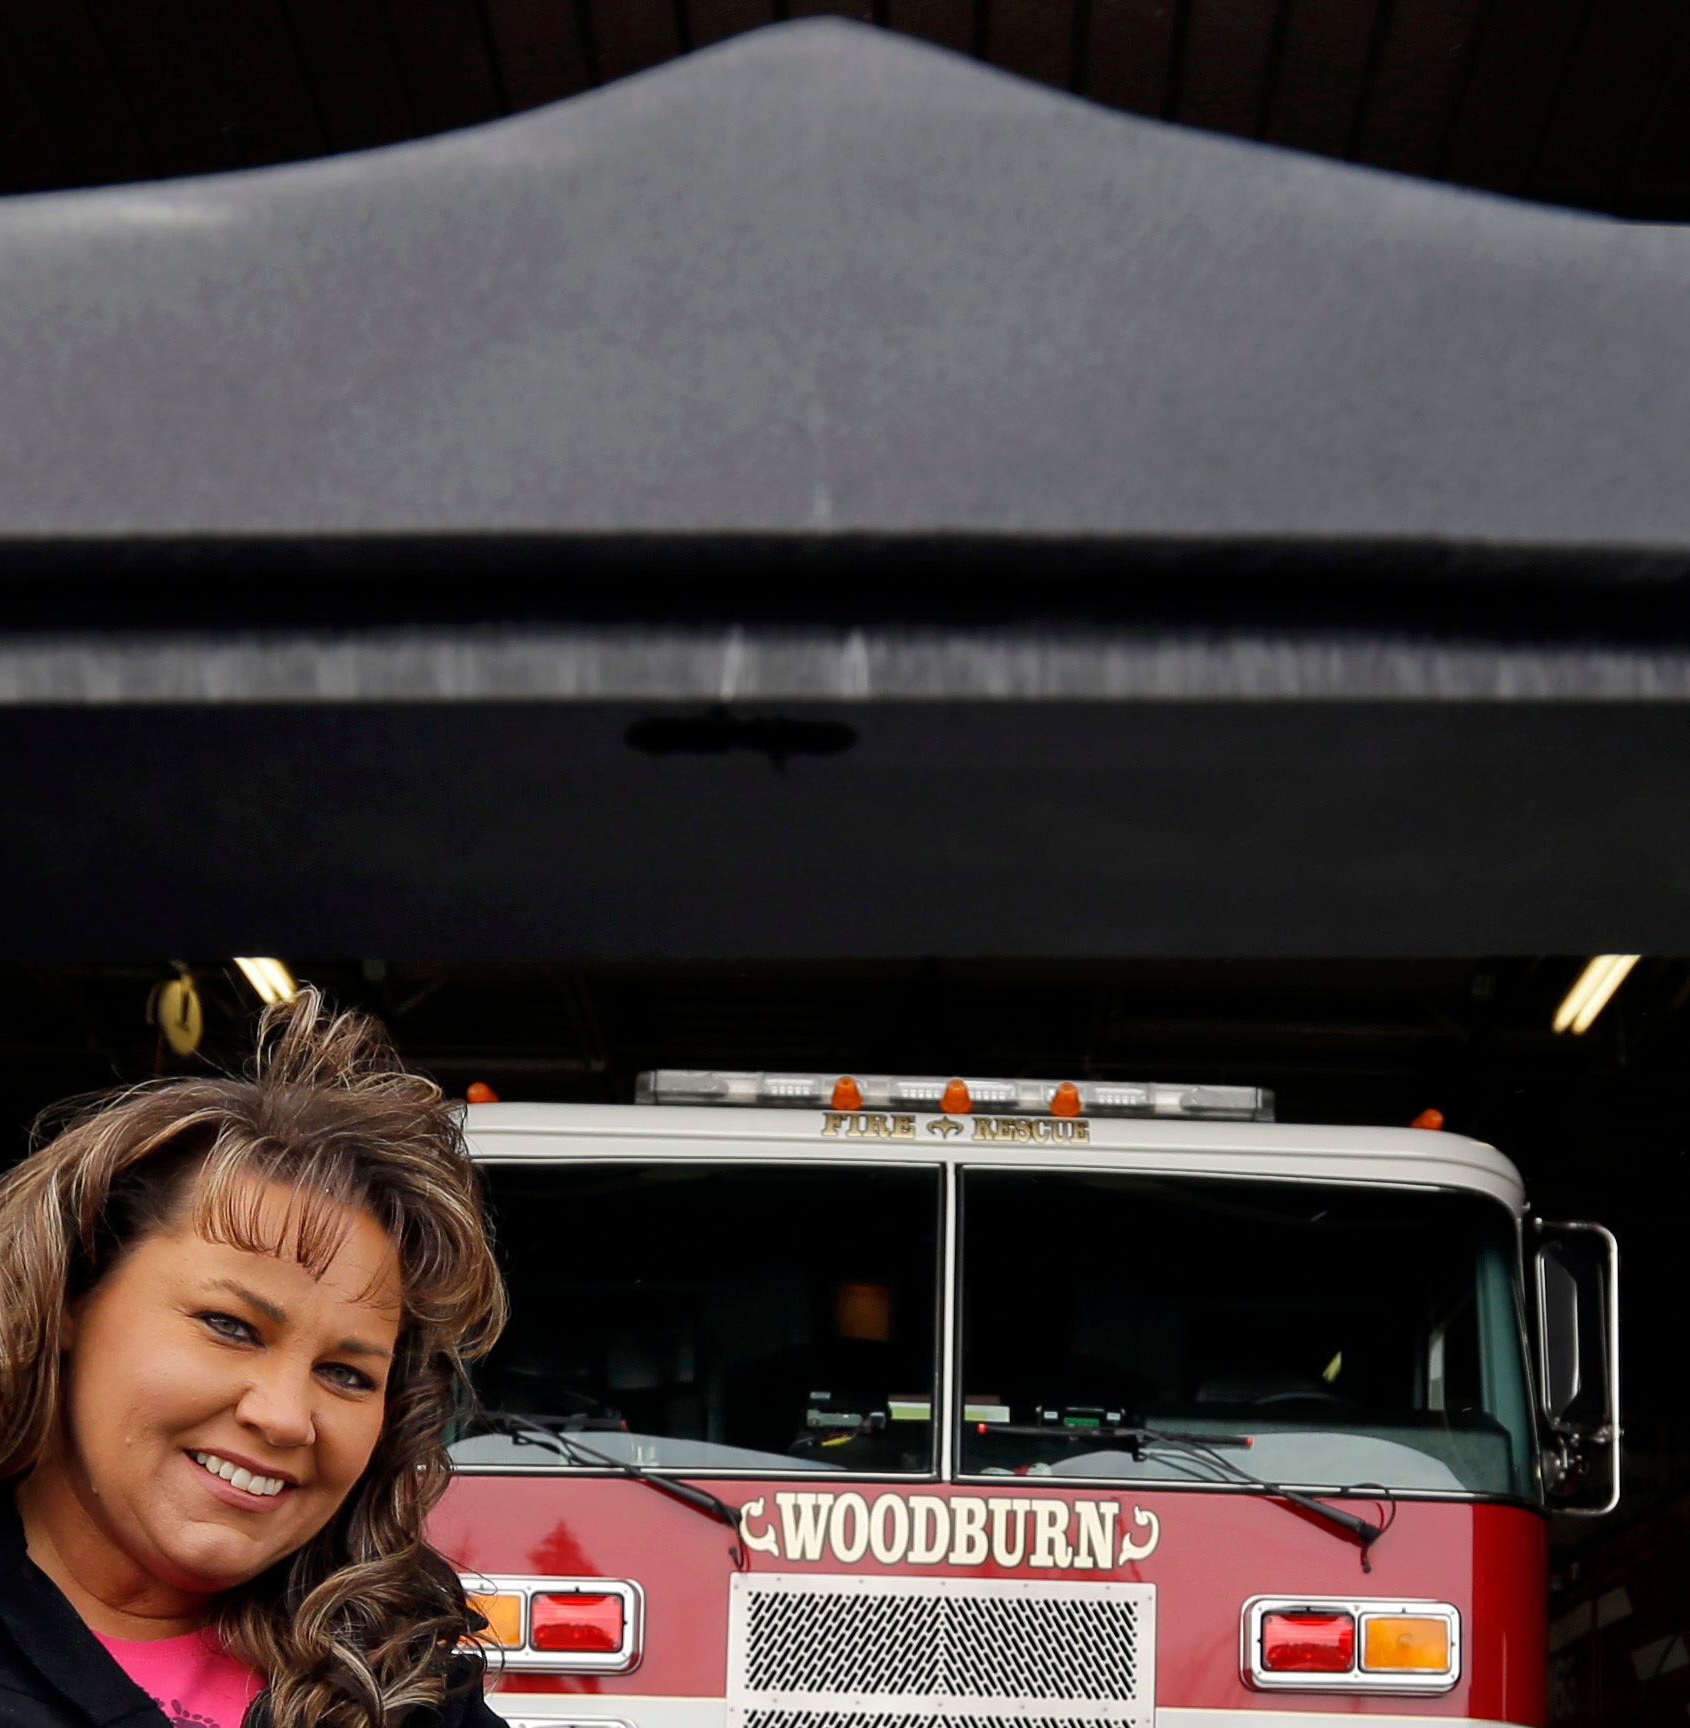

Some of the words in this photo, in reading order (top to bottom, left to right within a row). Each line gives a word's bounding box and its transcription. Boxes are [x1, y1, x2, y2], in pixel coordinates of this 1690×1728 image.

[821, 1111, 915, 1139] FIRE
[971, 1116, 1091, 1144] RESCUE
[774, 1491, 1121, 1570] WOODBURN
